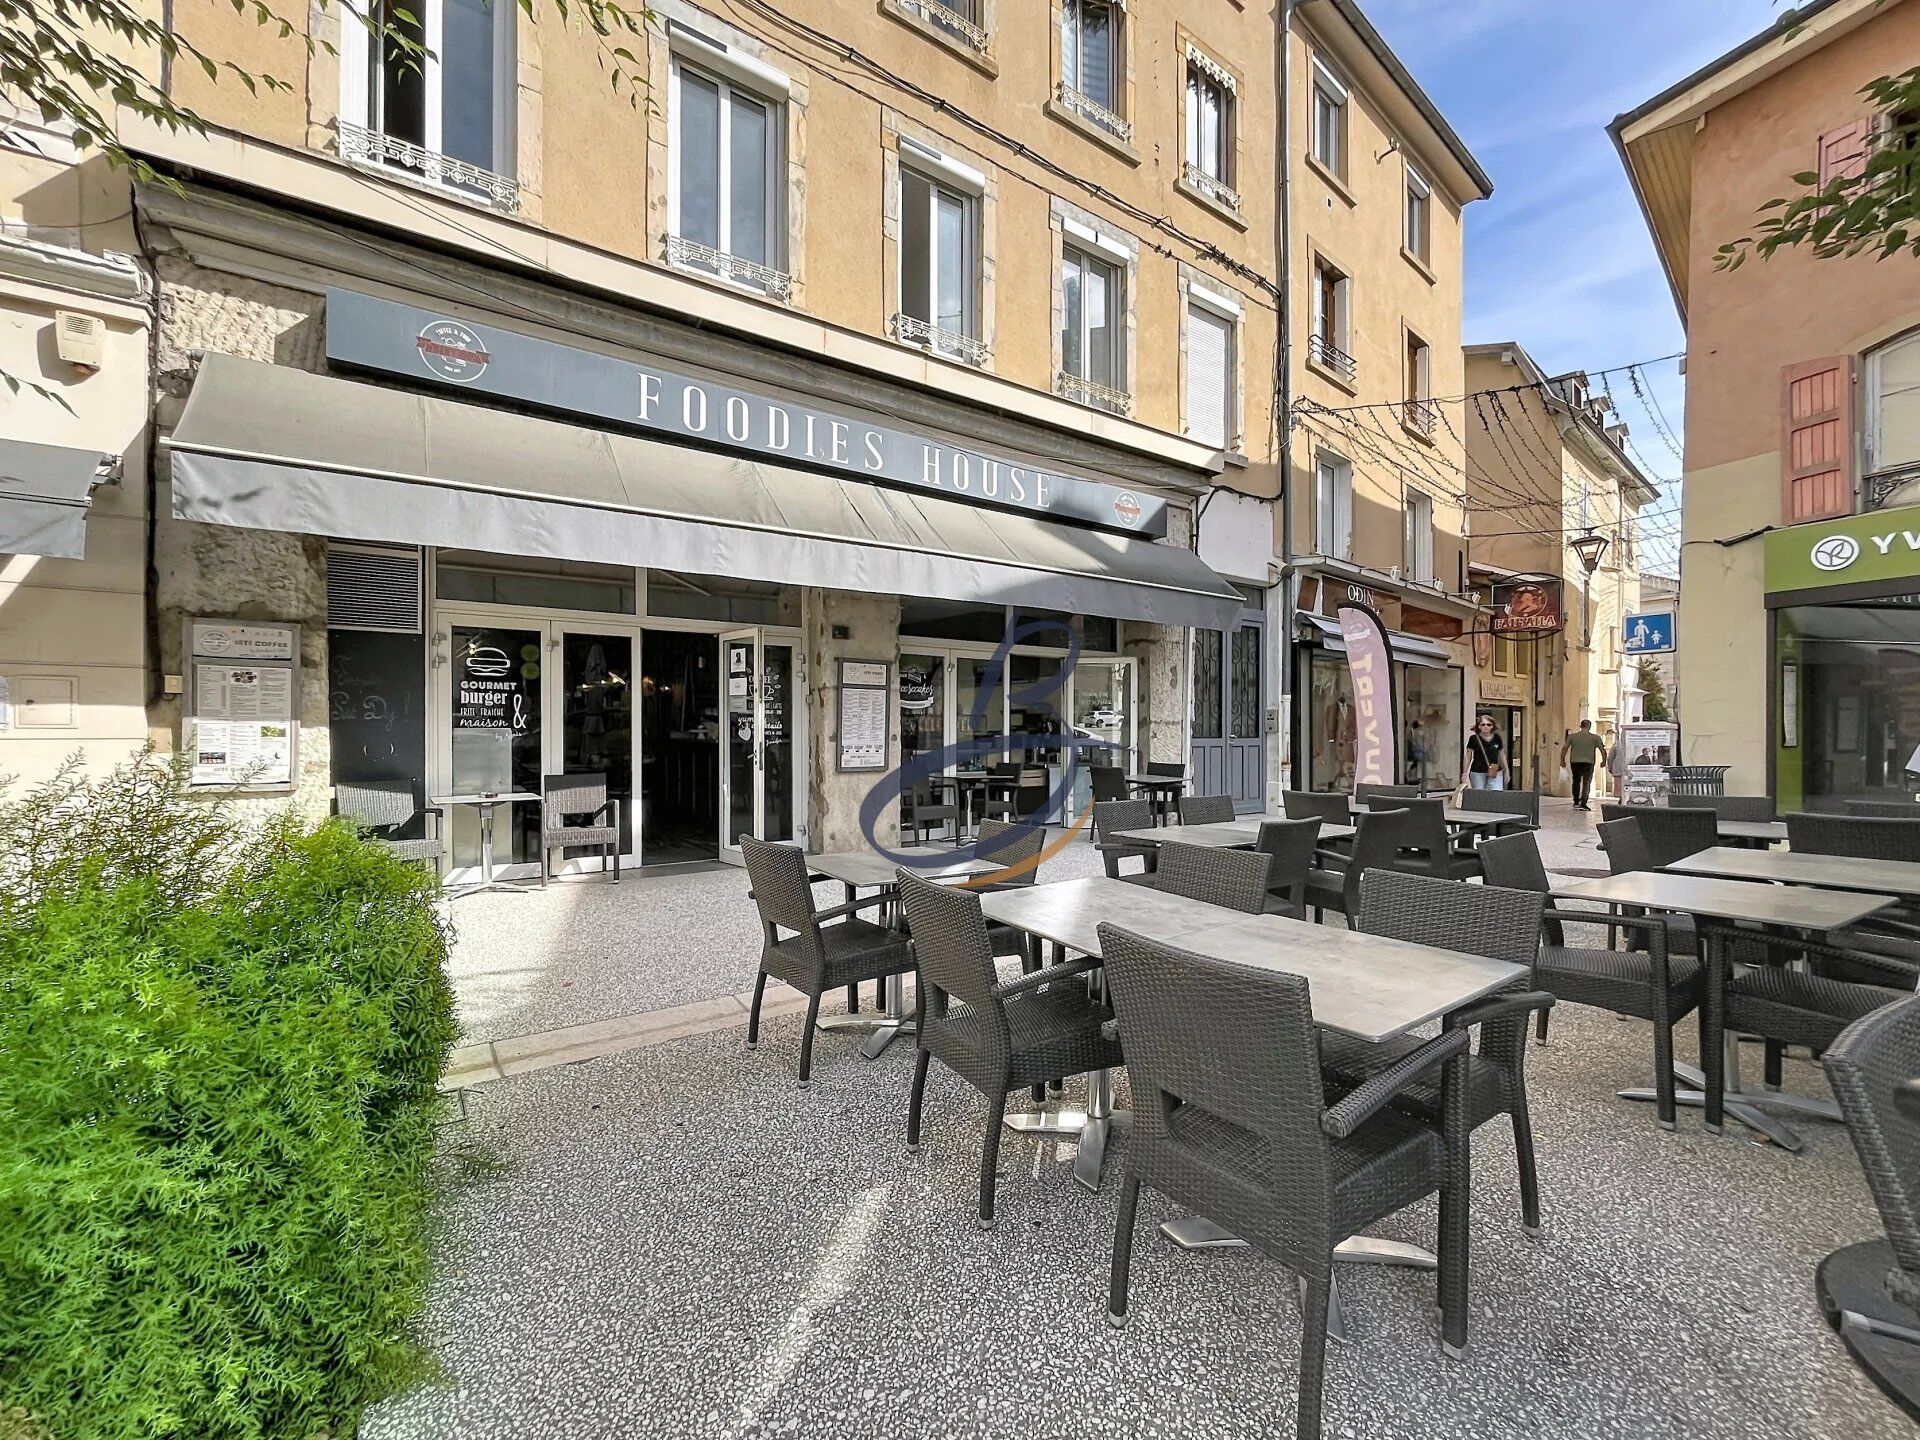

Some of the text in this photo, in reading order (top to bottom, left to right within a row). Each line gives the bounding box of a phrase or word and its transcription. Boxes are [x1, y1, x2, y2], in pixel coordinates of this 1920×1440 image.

[637, 372, 1051, 508] FOODIES HOUSE
[460, 681, 517, 690] GOURMET
[460, 690, 508, 706] burger
[513, 694, 527, 729] &
[460, 718, 509, 728] maison
